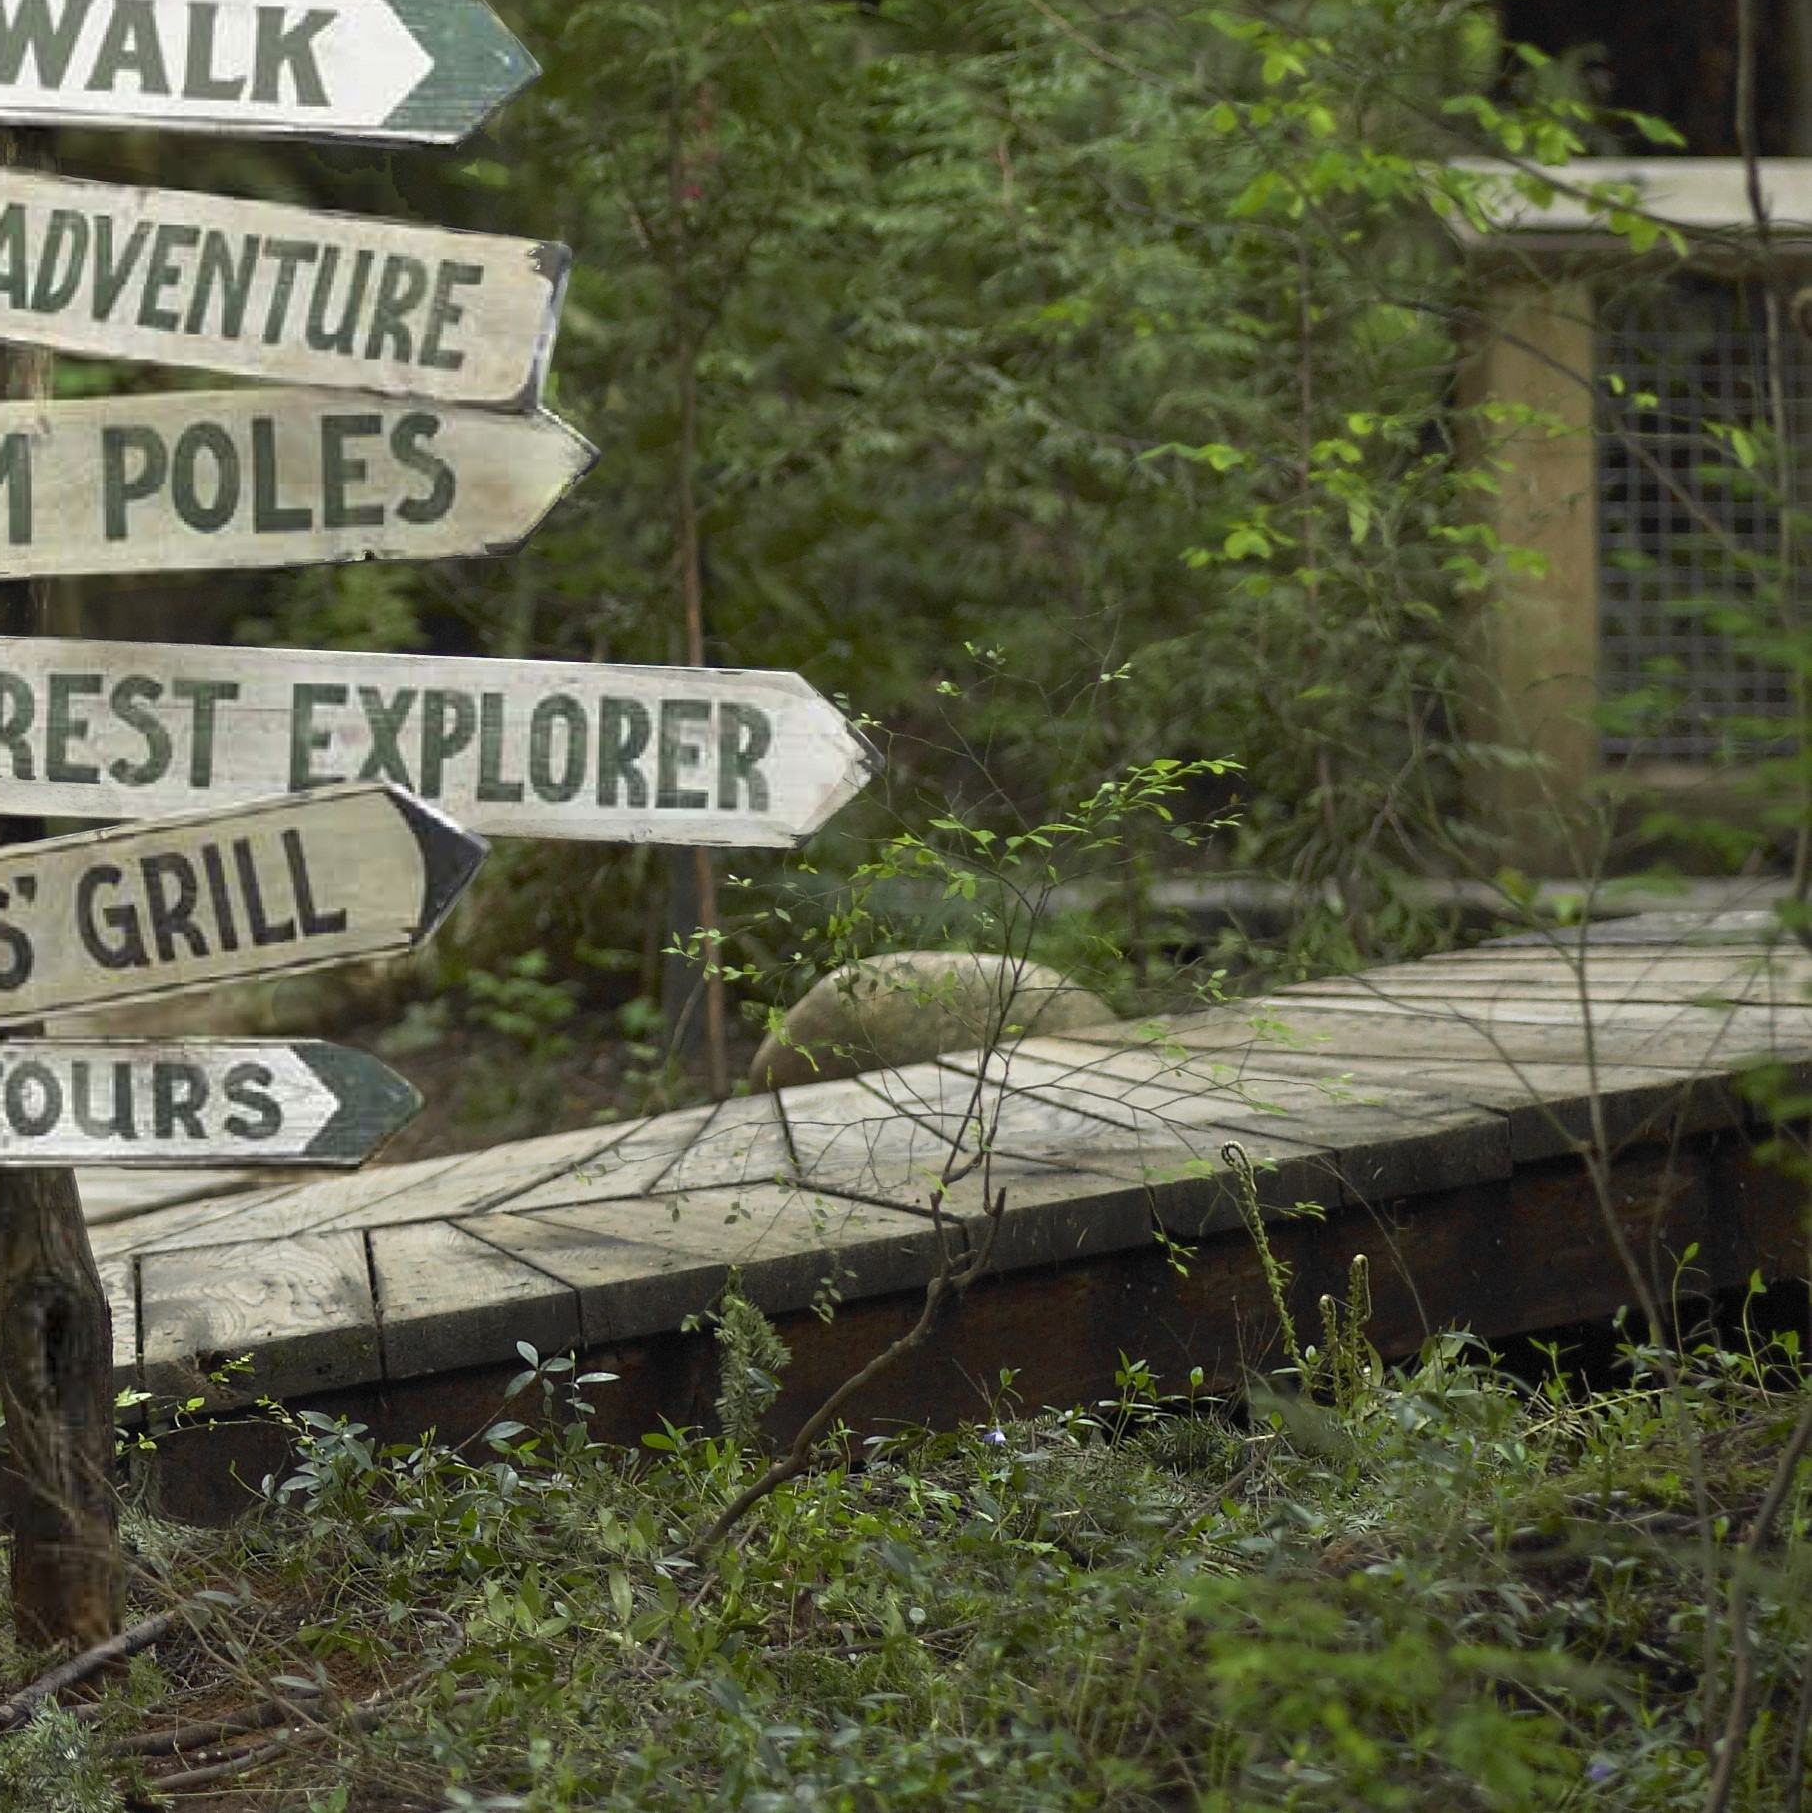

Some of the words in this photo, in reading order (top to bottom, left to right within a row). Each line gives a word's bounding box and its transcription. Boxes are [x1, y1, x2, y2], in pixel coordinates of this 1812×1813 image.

[103, 412, 456, 541] POLES
[290, 683, 772, 811] EXPLORER
[78, 828, 348, 970] GRILL
